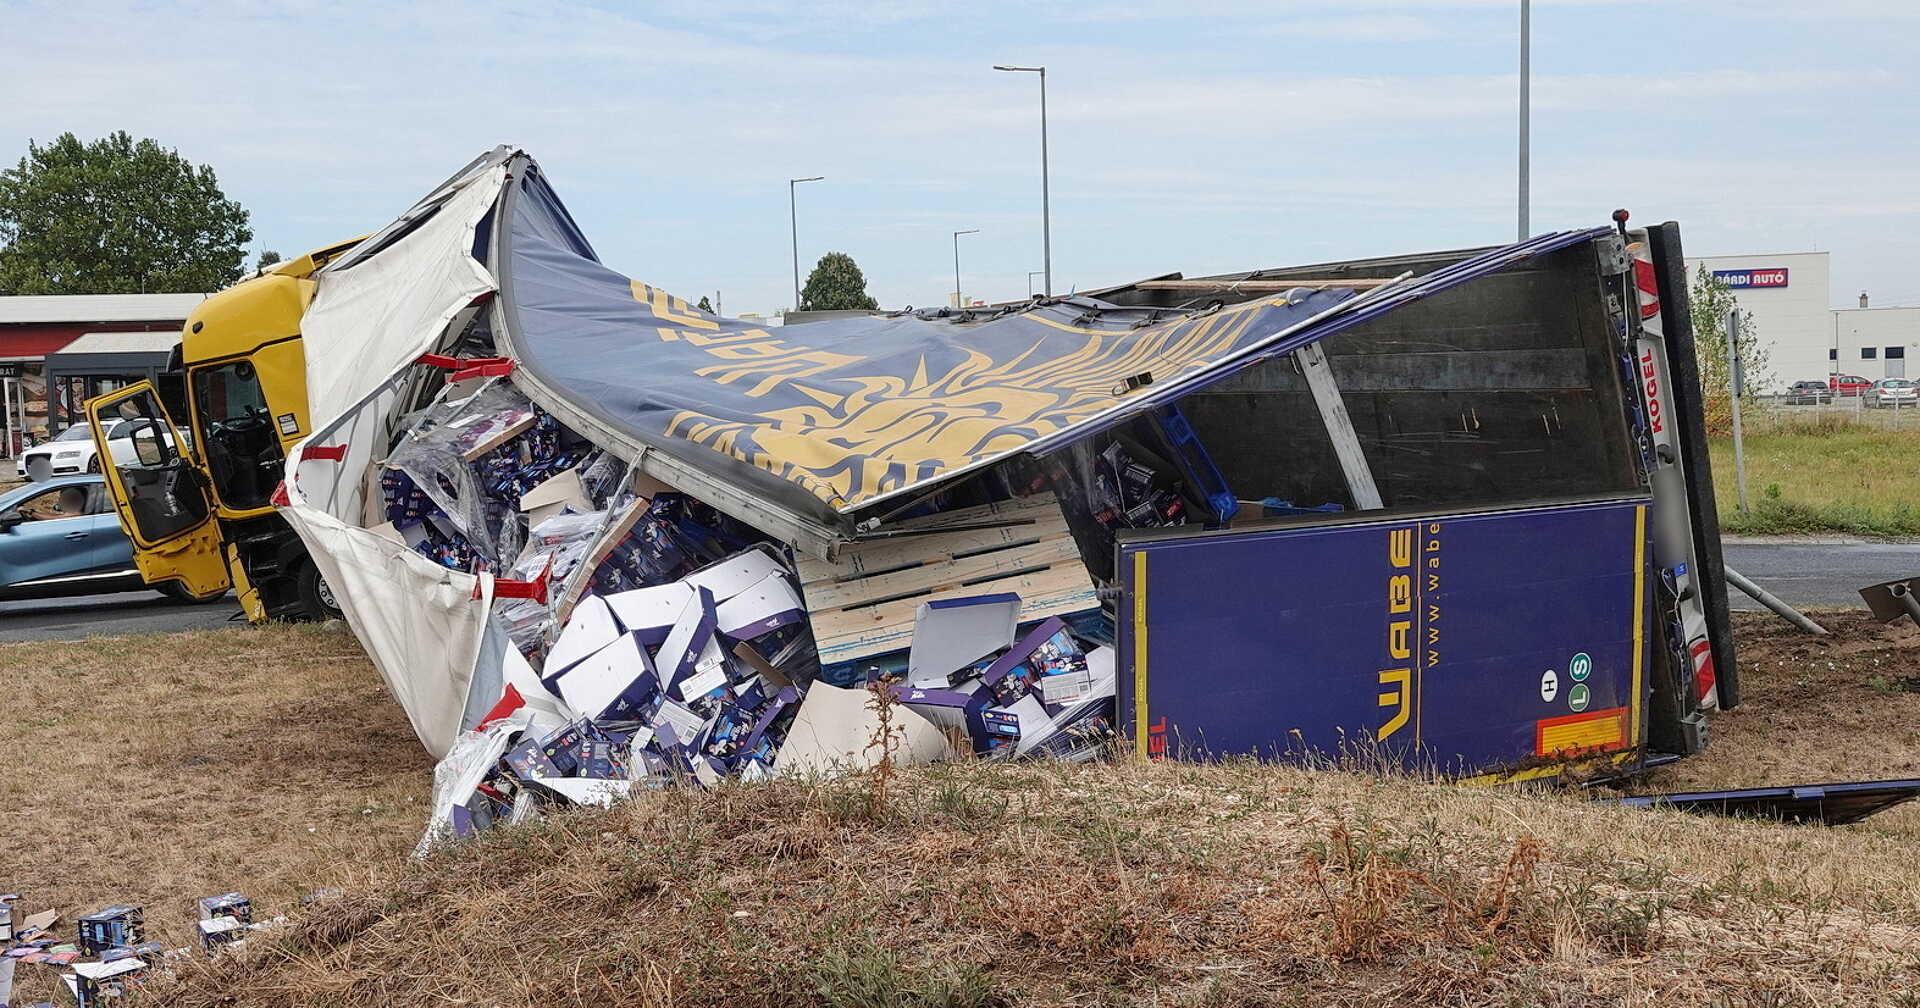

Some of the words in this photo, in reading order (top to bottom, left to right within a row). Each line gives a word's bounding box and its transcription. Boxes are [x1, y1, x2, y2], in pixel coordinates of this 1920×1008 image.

[1753, 271, 1785, 284] AUTÓ
[1376, 528, 1412, 743] WABE
[1573, 659, 1588, 675] S
[1543, 679, 1556, 692] H
[1572, 690, 1587, 704] L
